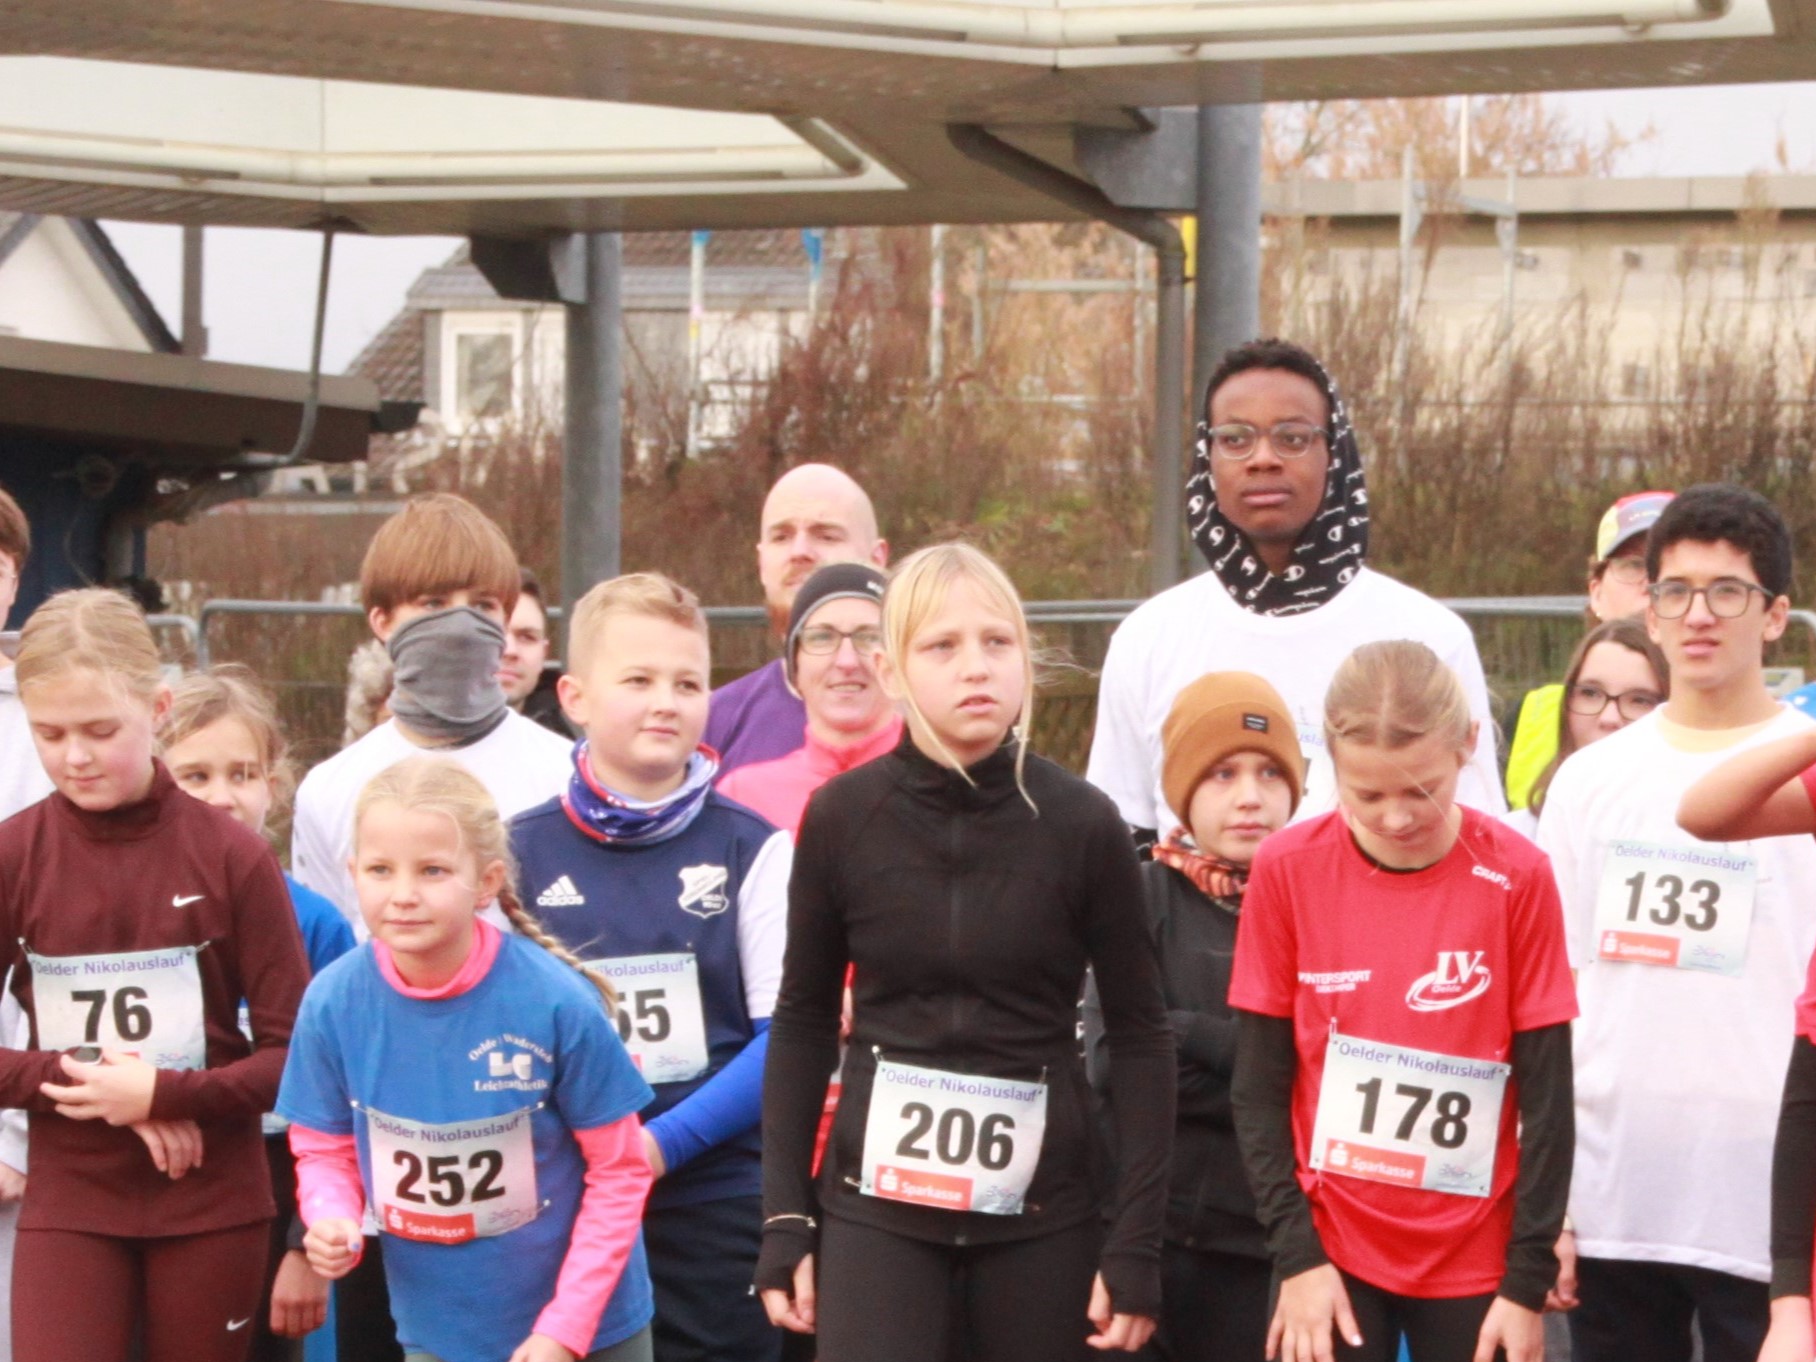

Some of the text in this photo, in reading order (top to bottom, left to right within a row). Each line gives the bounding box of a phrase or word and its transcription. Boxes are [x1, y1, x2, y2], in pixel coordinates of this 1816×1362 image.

[1615, 844, 1747, 872] Oelder Nikolauslauf
[1624, 870, 1722, 932] 133
[36, 952, 186, 976] Oelder Nikolauslauf
[1299, 969, 1372, 985] INTERSPORT
[1435, 950, 1486, 985] LV
[71, 985, 153, 1043] 76
[1339, 1041, 1497, 1080] Oelder Nikolauslauf
[885, 1068, 1038, 1103] Oelder Nikolauslauf
[374, 1116, 521, 1143] Oelder Nikolauslauf
[1355, 1076, 1472, 1149] 178
[895, 1101, 1016, 1172] 206
[393, 1149, 507, 1207] 252
[1351, 1156, 1415, 1180] Sparkasse
[901, 1181, 963, 1203] Sparkasse
[406, 1222, 467, 1239] Sparkasse
